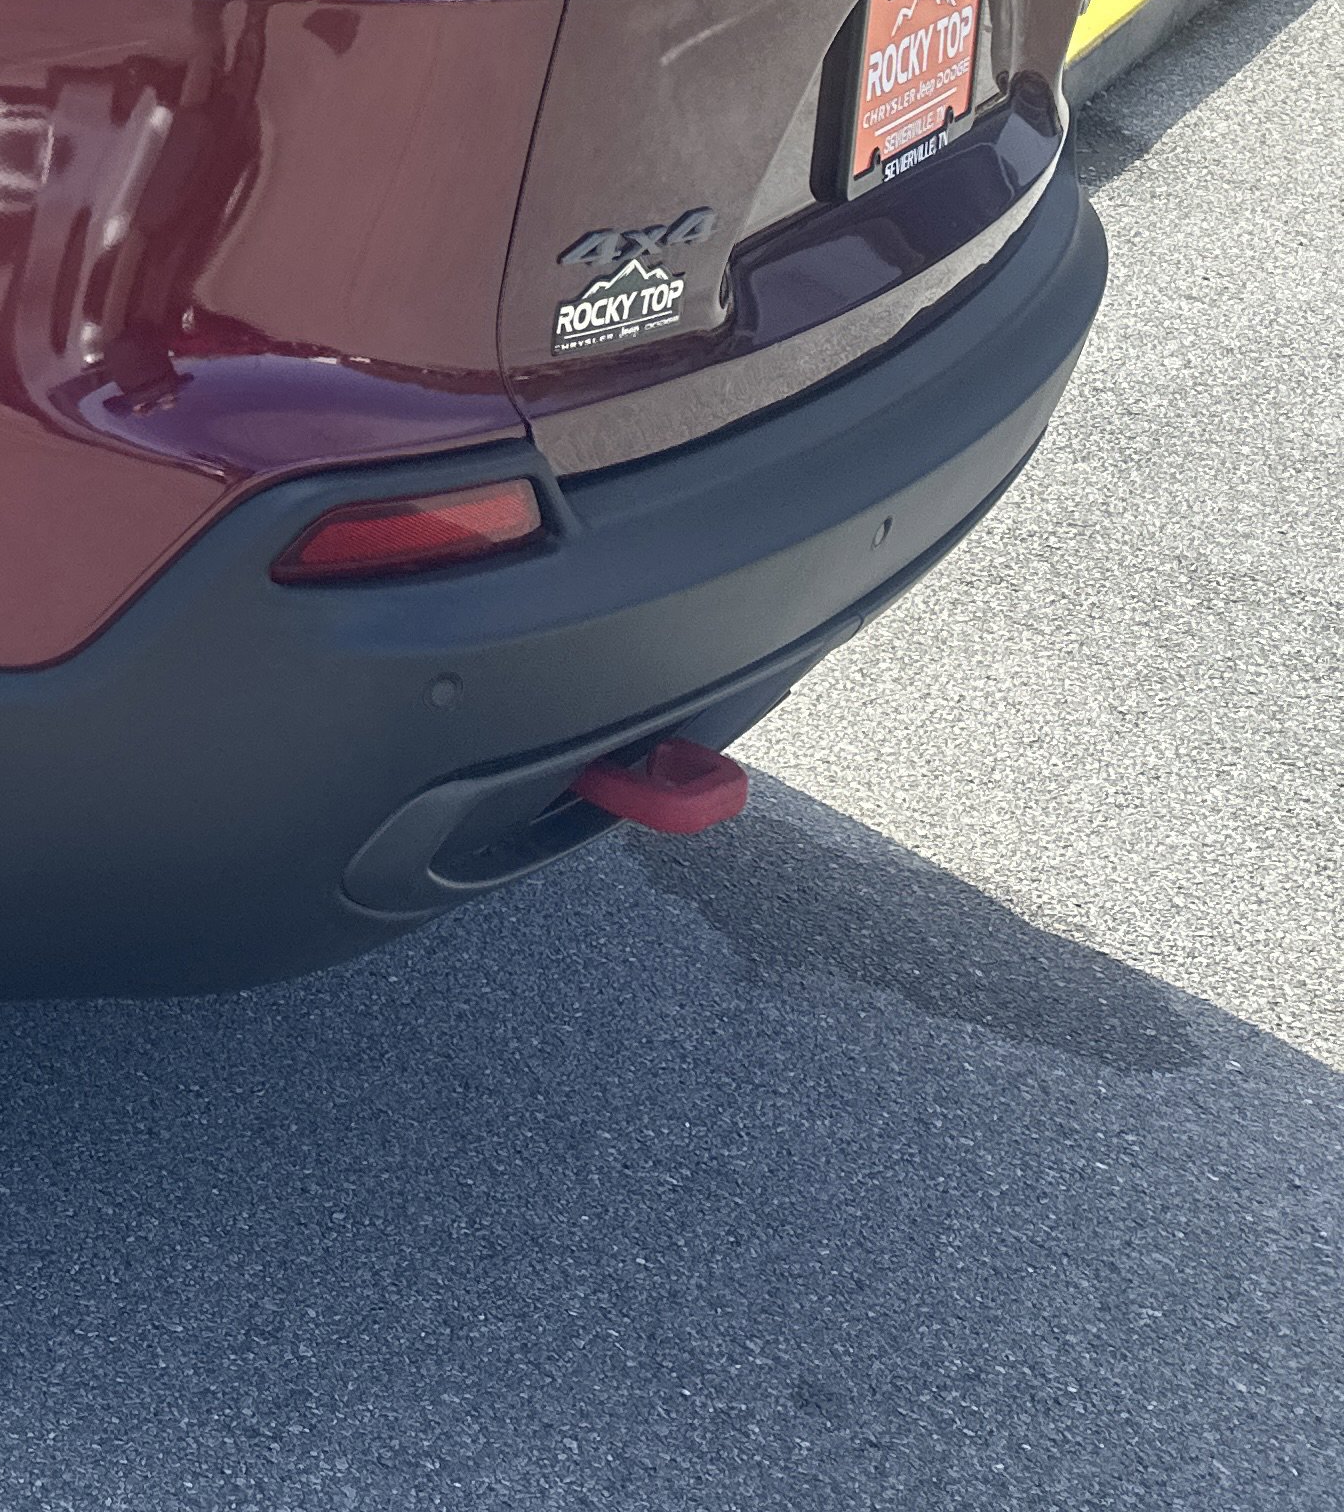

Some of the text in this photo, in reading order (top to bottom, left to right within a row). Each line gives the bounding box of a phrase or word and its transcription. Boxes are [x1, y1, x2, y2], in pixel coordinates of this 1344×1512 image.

[865, 5, 974, 102] ROCKY TOP
[862, 57, 971, 129] CHRYSLER Jeep DODGE
[556, 206, 714, 265] 4x4
[556, 279, 684, 335] ROCKY TOP
[554, 332, 614, 352] CHRYSLER
